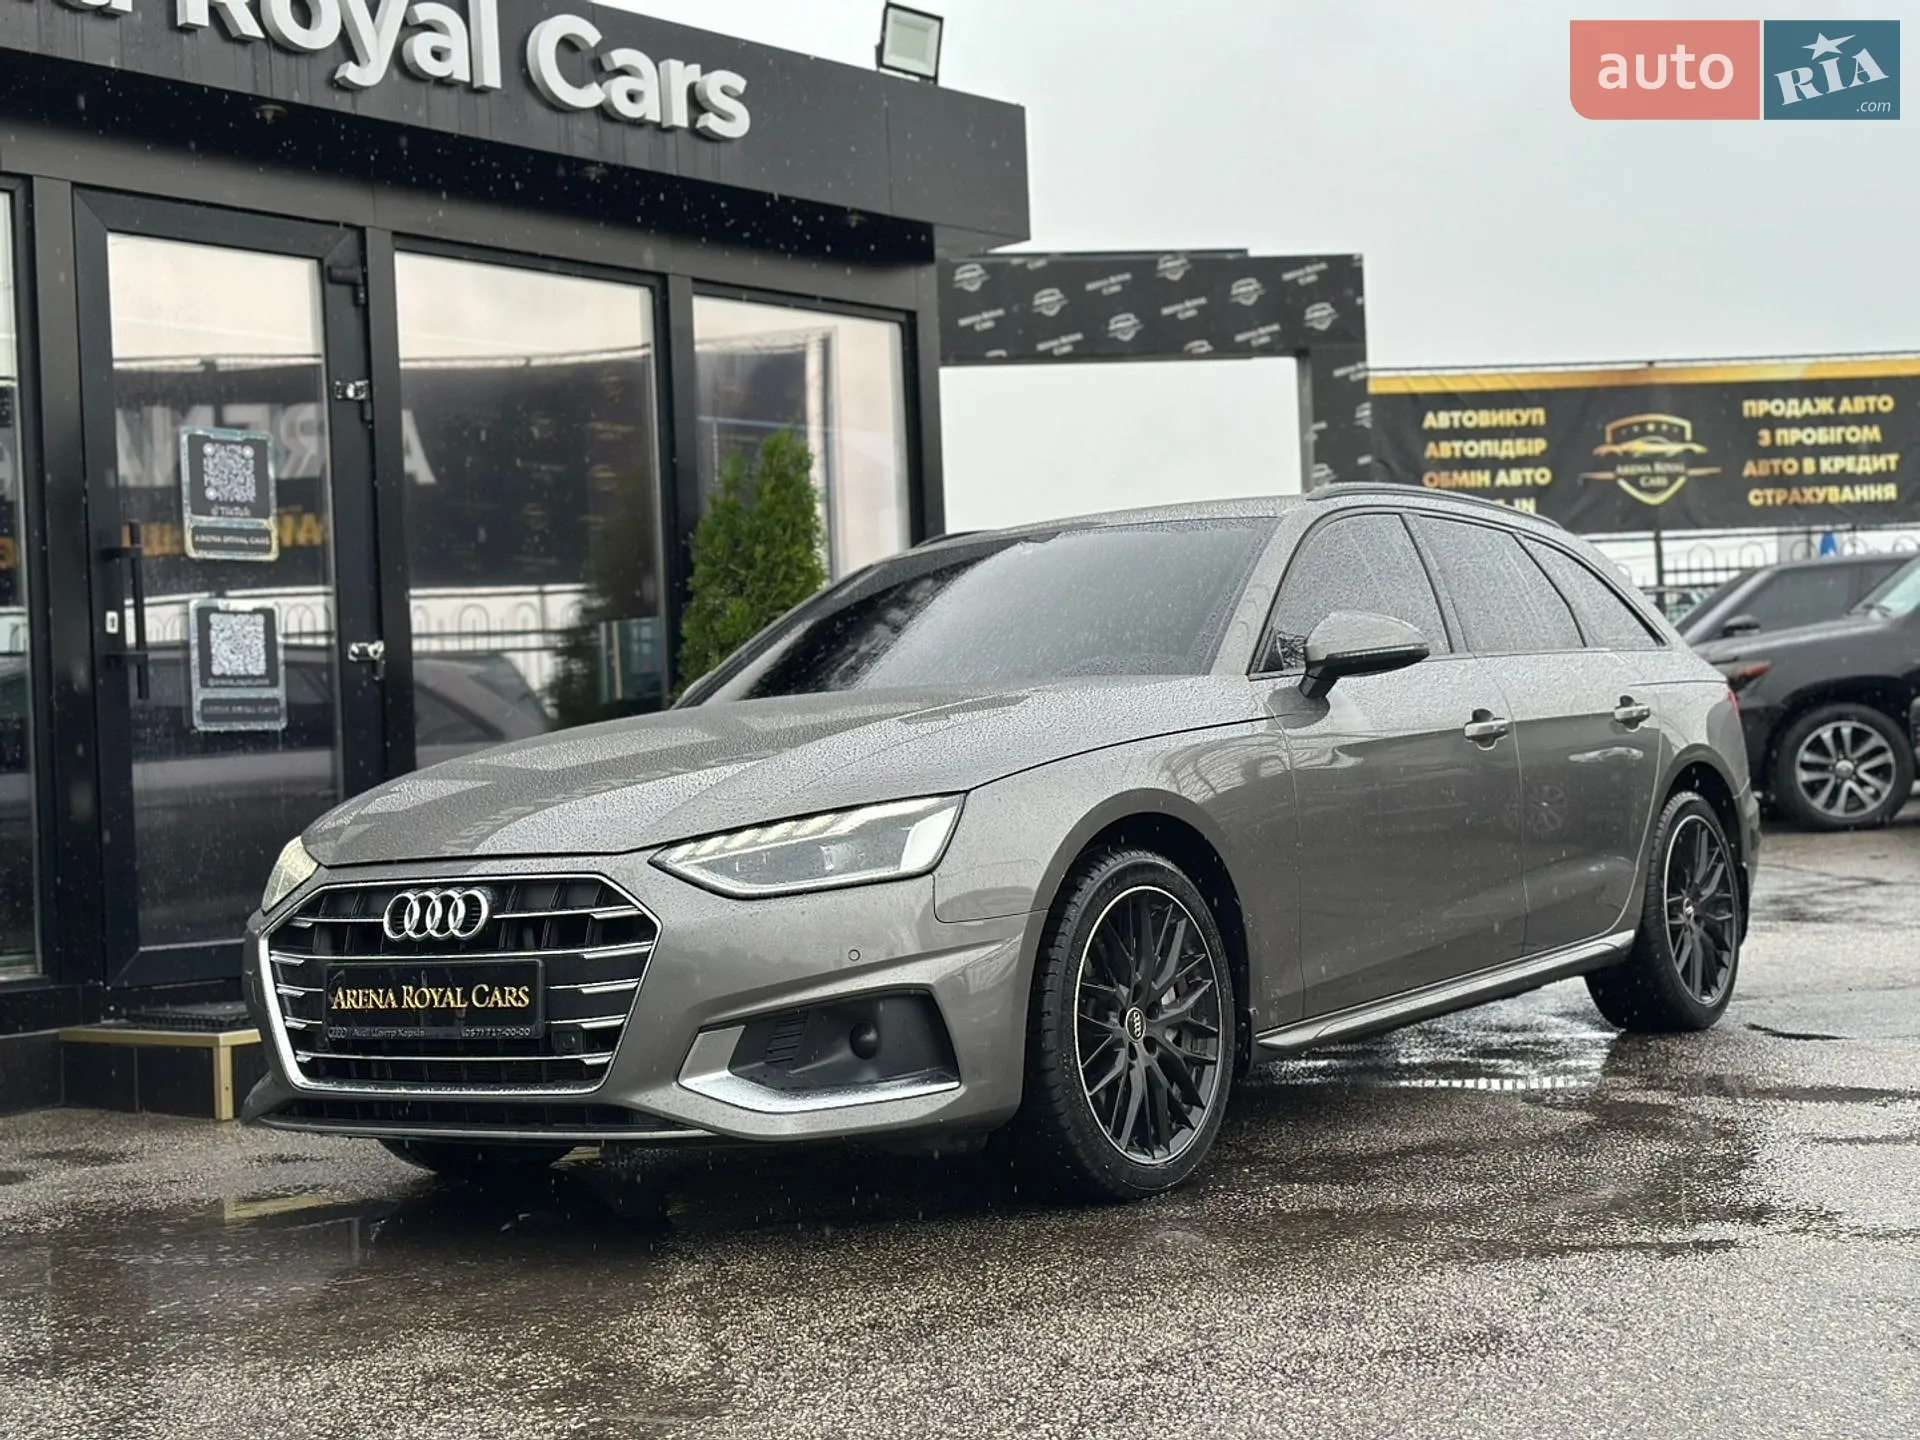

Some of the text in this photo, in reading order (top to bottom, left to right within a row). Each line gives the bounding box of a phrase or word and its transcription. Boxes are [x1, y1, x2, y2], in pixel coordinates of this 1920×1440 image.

[527, 14, 751, 141] Cars
[1422, 407, 1547, 430] АВТОВИКУП
[1742, 395, 1895, 419] ПРОДАЖ АВТО
[1775, 424, 1882, 446] ПРОБІГОМ
[1424, 437, 1549, 461] АВТОПІДБІР
[1742, 453, 1901, 478] АВТО В КРЕДИТ
[1422, 467, 1553, 489] ОБМІН АВТО
[1747, 483, 1898, 507] СТРАХУВАННЯ
[331, 984, 530, 1010] ARENA ROYAL CARS
